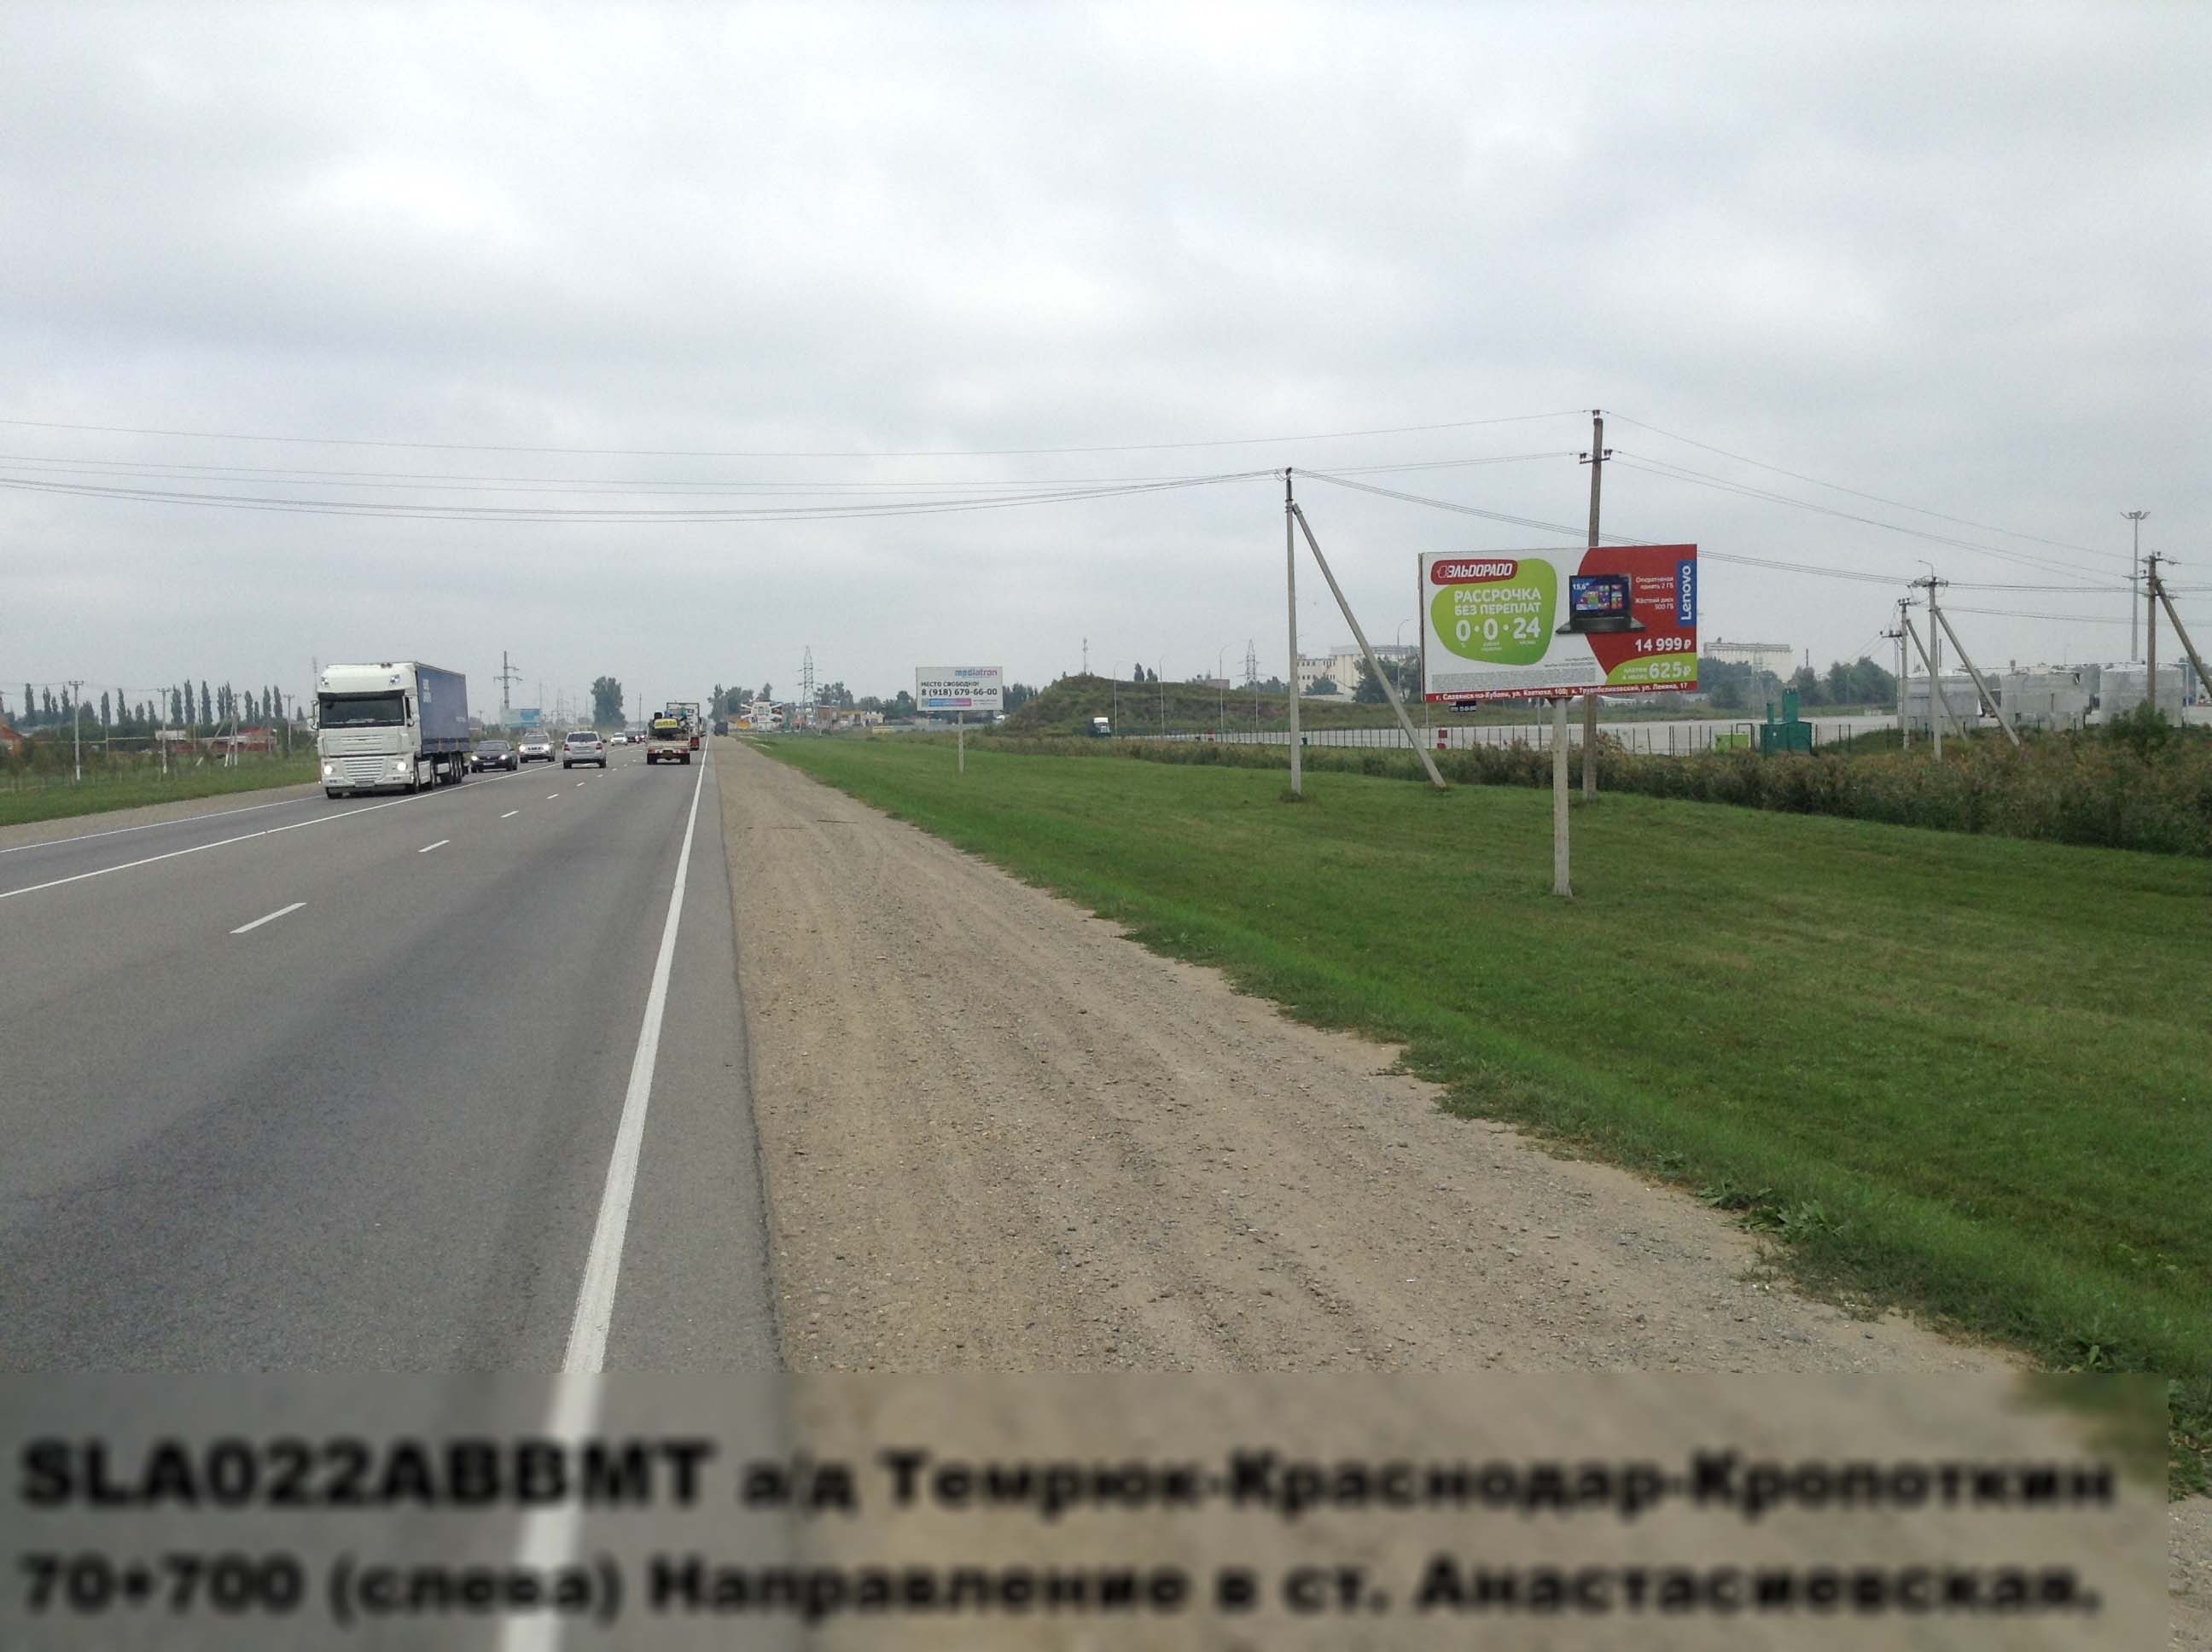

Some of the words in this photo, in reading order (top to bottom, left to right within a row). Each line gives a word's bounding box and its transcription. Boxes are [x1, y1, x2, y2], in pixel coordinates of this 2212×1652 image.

[1453, 587, 1541, 603] РАССРОЧКА
[1680, 565, 1691, 621] Lenovo
[1454, 605, 1477, 616] БЕЗ
[1480, 602, 1542, 615] ПЕРЕПЛАТ
[1635, 638, 1653, 652] 14
[928, 688, 952, 697] (918)
[954, 688, 998, 696] 679-66-00
